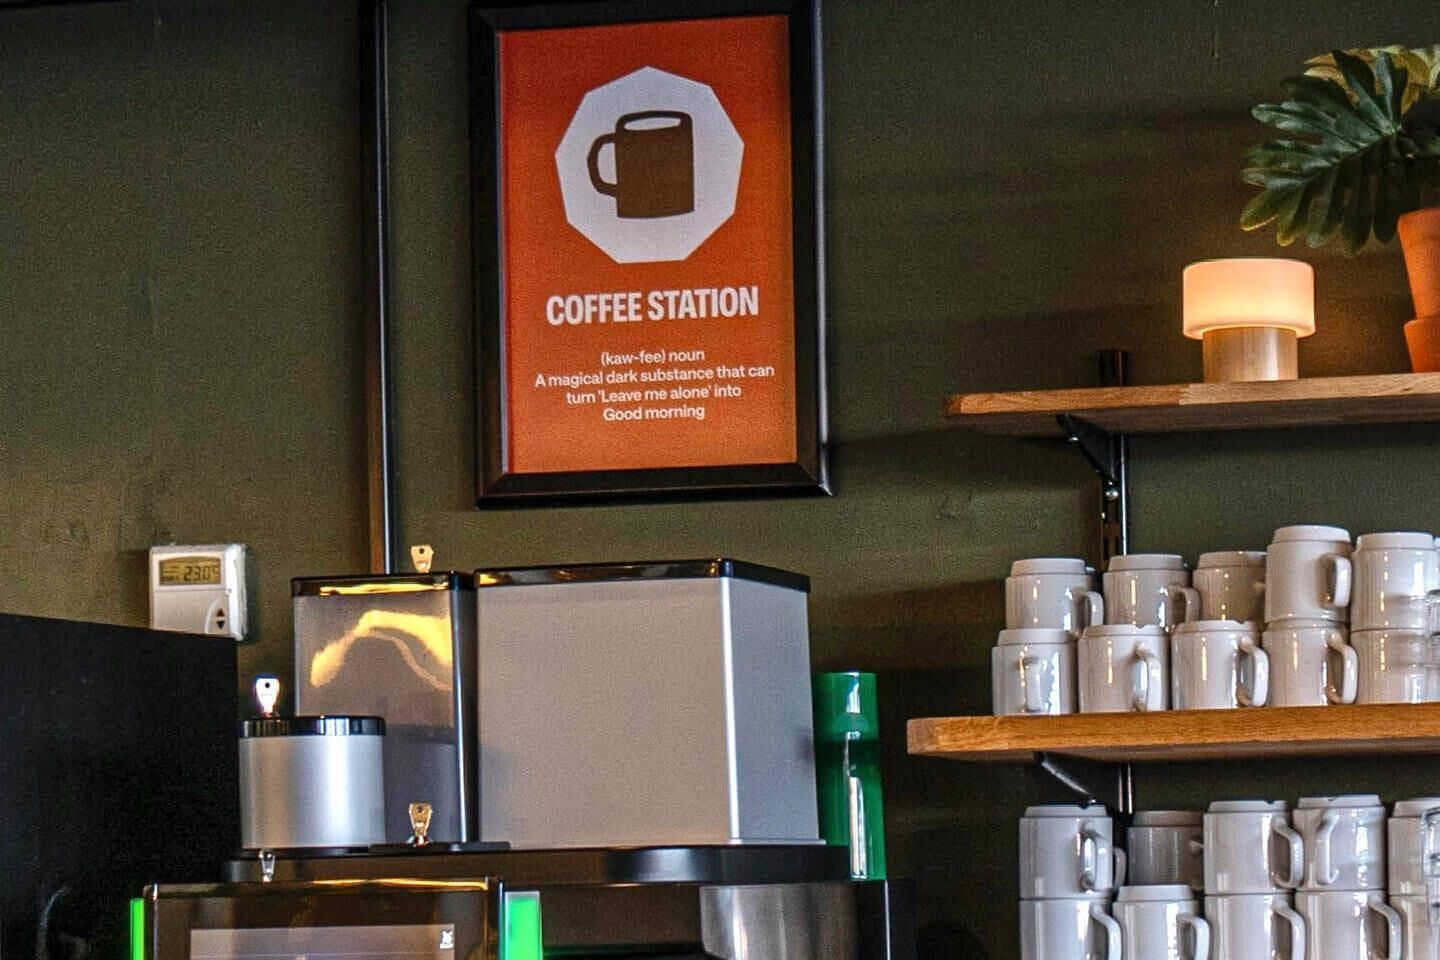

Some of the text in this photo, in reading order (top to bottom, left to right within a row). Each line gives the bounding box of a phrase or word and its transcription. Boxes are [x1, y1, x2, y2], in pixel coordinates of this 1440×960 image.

[546, 286, 759, 326] COFFEE STATION
[600, 350, 705, 367] (kaw-fee) noun
[534, 365, 775, 389] A magical dark substance that can
[566, 384, 741, 405] turn 'Leave me alone' into
[603, 405, 705, 422] Good morning
